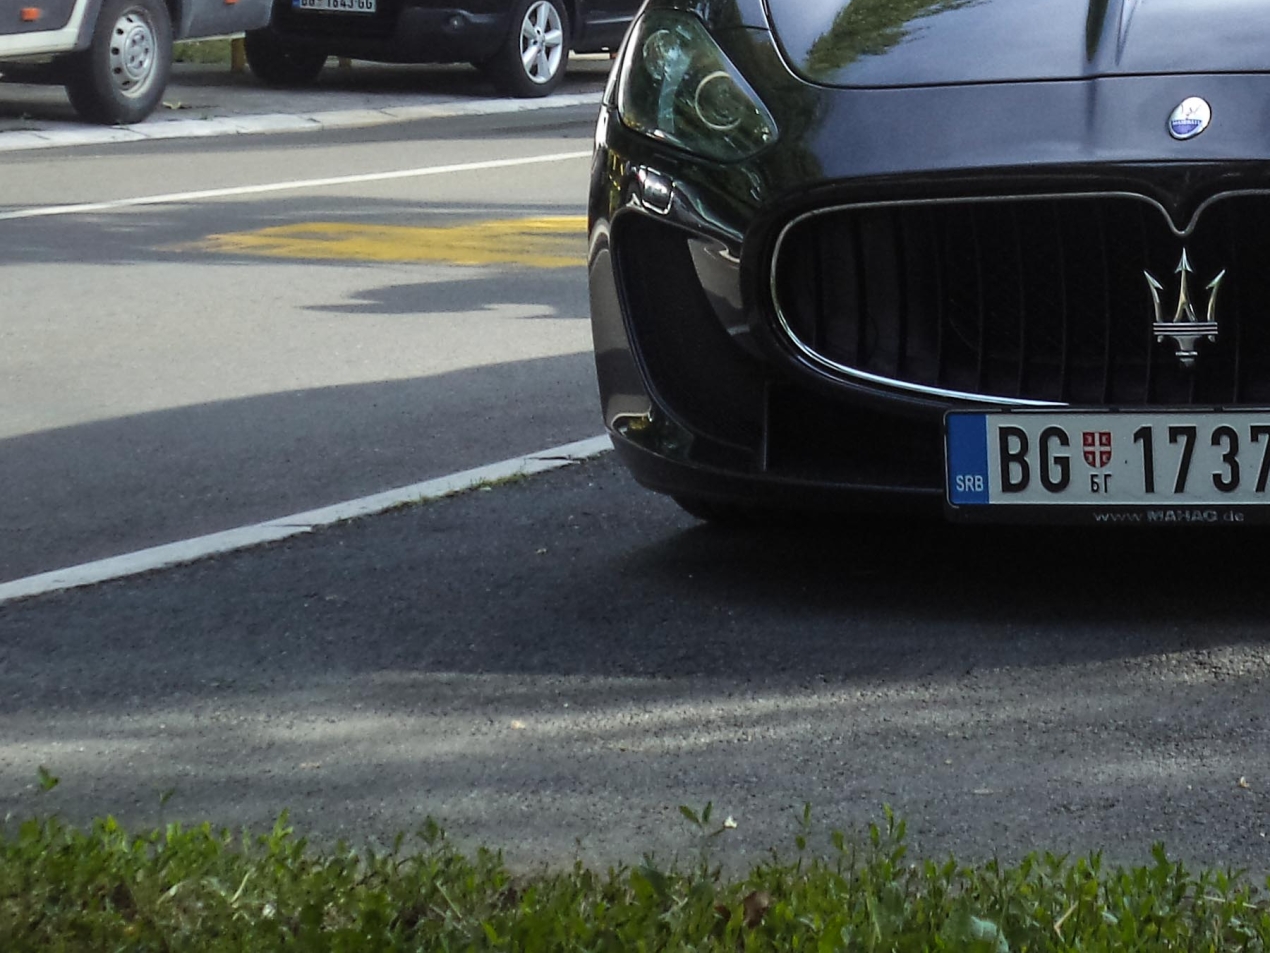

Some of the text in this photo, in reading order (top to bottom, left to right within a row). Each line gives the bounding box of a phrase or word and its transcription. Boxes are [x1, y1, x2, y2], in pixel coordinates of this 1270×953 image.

[998, 424, 1071, 494] BG
[955, 474, 984, 493] SRB
[1090, 472, 1113, 494] БГ
